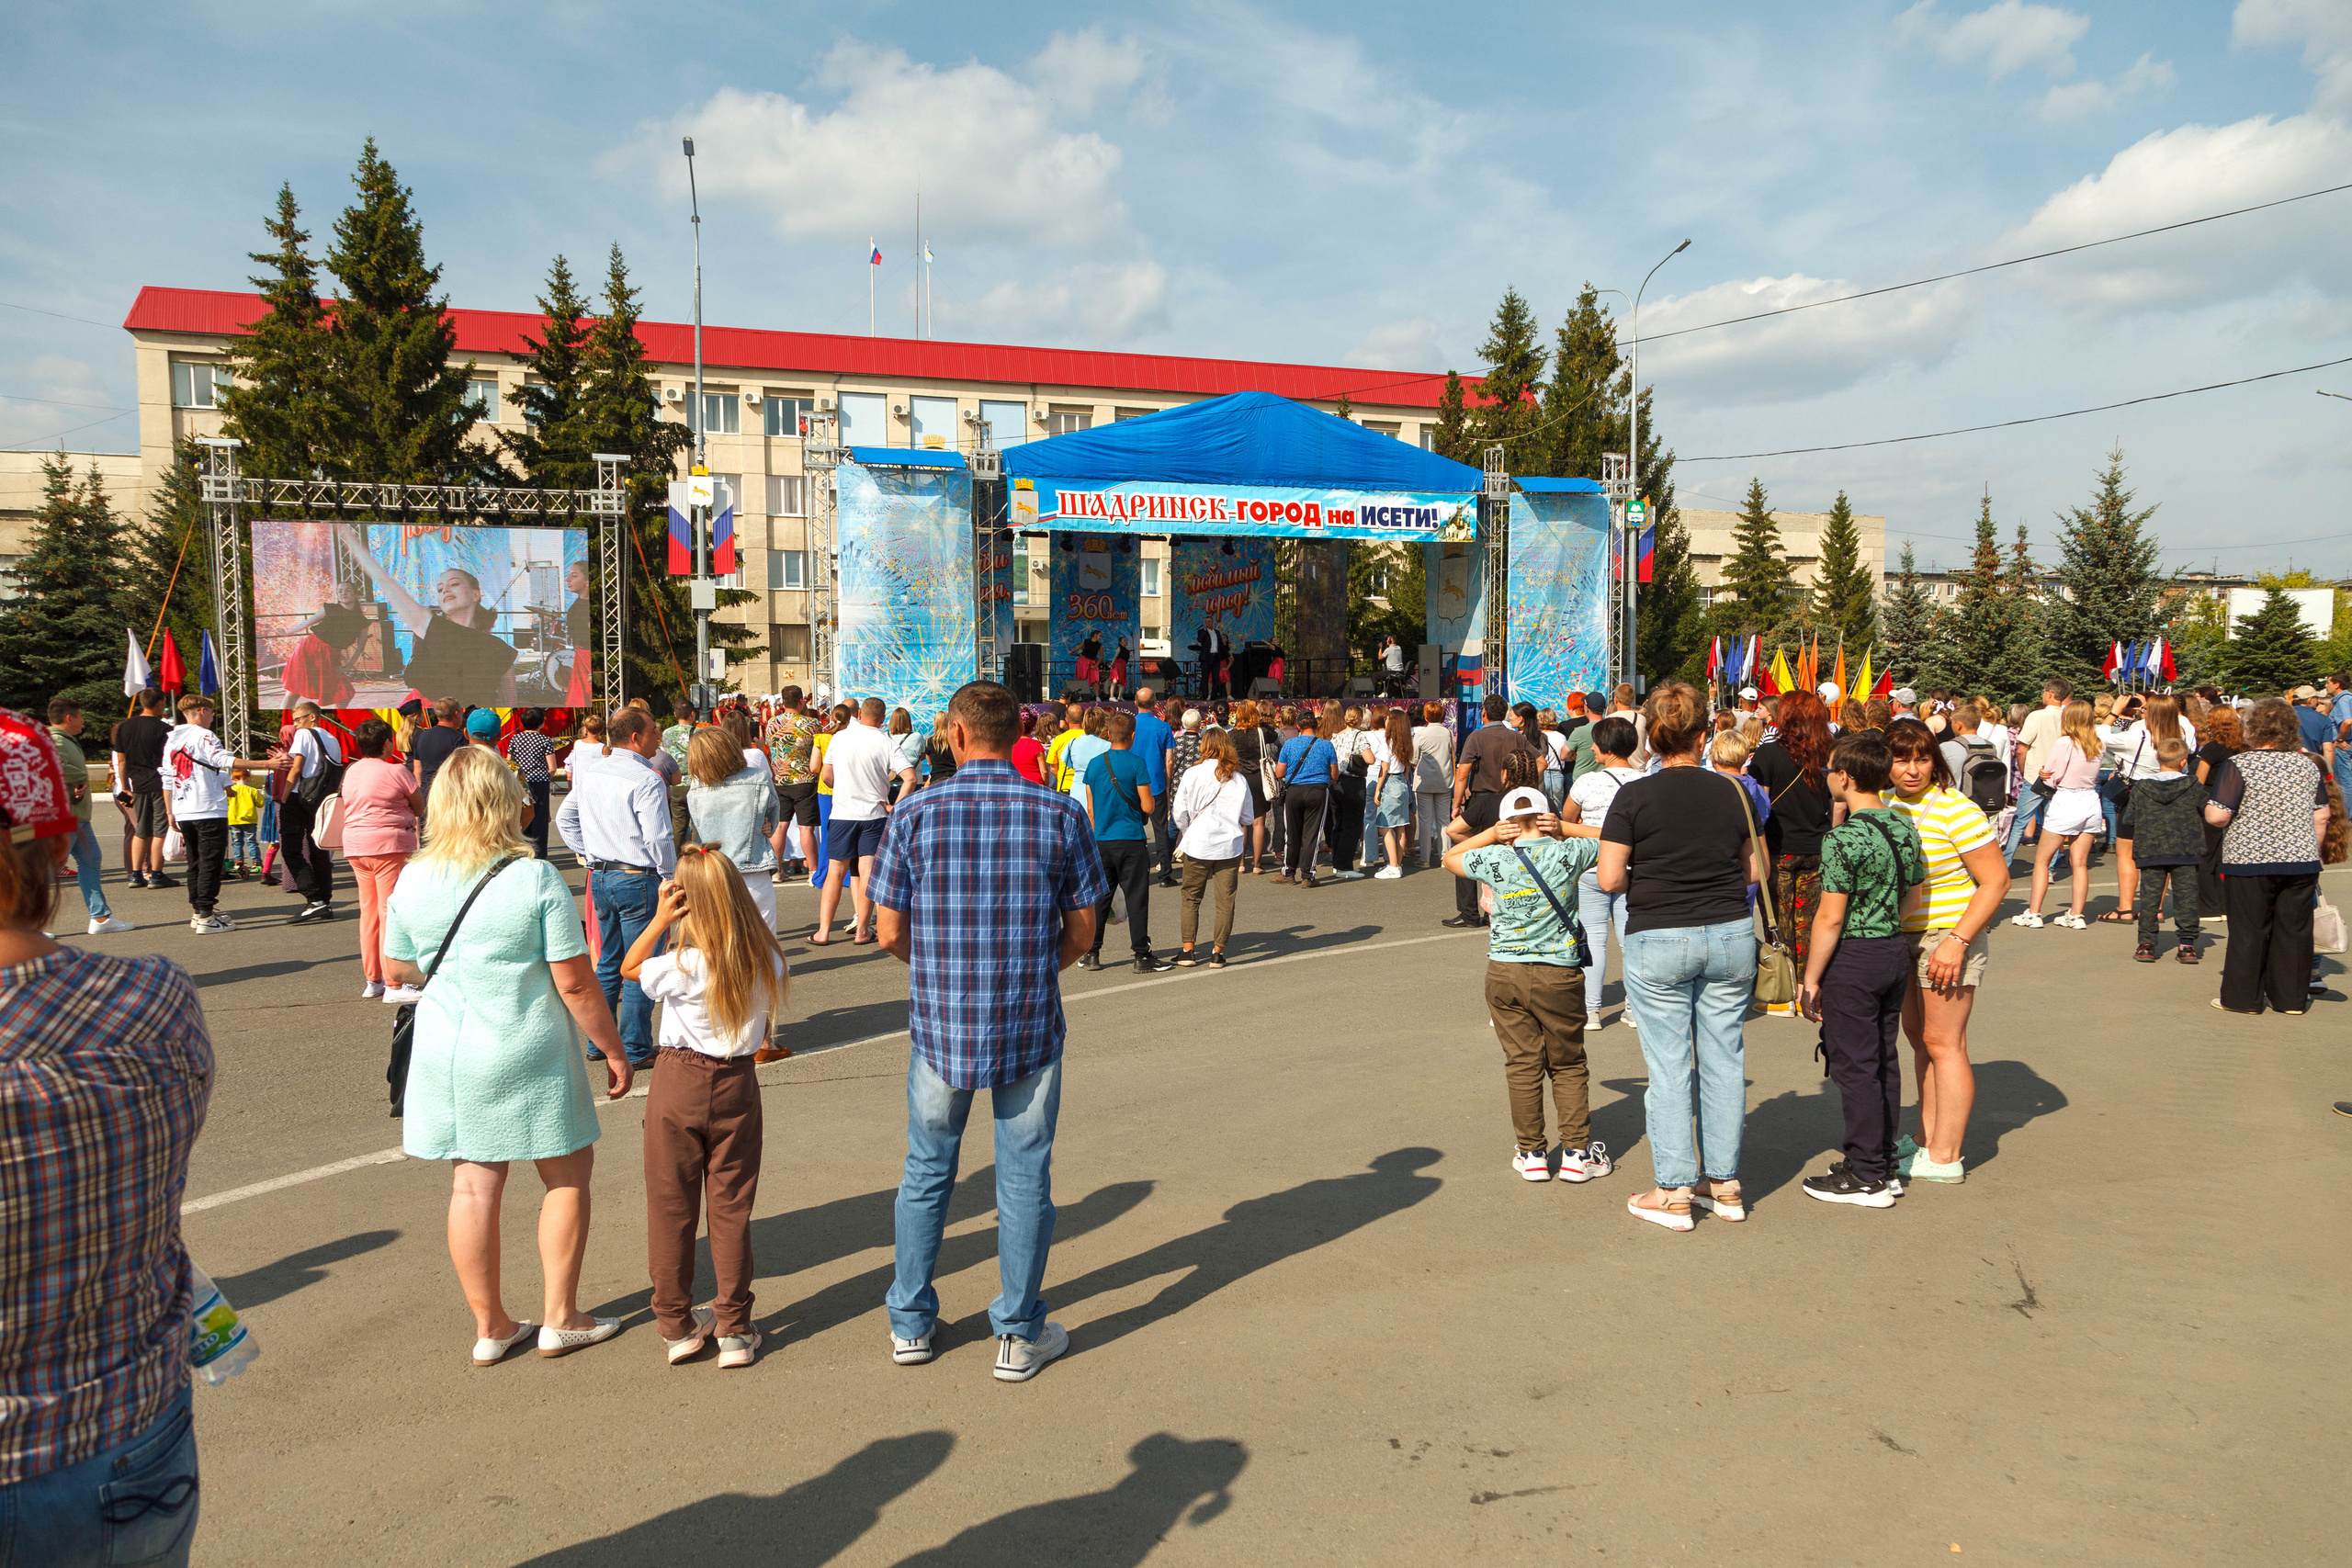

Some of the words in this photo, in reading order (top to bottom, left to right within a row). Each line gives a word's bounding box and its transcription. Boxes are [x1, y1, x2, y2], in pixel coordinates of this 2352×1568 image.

[1327, 509, 1355, 525] на
[1361, 505, 1439, 528] ИСЕТИ!
[1186, 558, 1261, 594] любимый
[1067, 592, 1114, 620] 360
[1204, 581, 1250, 622] город!
